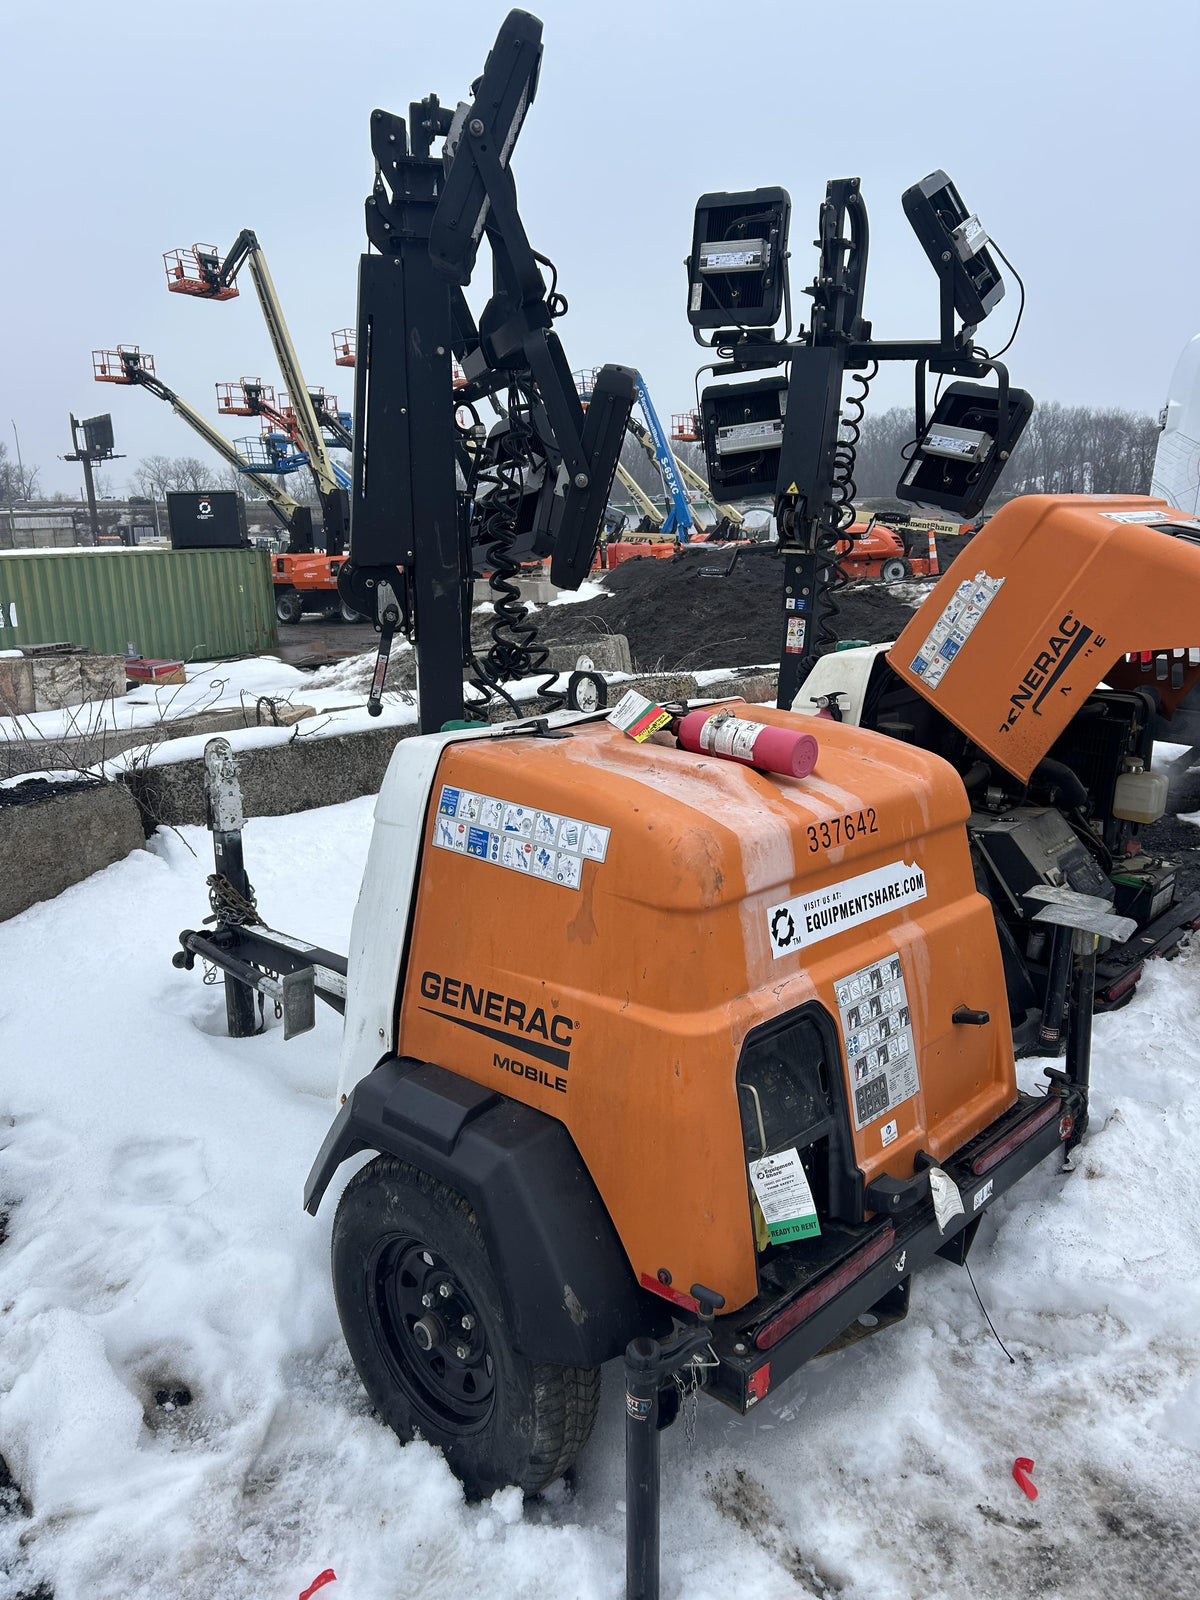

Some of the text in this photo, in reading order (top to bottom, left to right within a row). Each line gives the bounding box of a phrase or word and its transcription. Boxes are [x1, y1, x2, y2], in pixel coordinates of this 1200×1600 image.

[660, 457, 680, 495] S-65 XC
[806, 808, 879, 852] 337642
[803, 891, 842, 912] VISIT US AT:
[805, 874, 924, 933] EQUIPMENTSHARE.COM
[420, 971, 574, 1047] GENERAC
[492, 1053, 568, 1093] MOBILE
[764, 1161, 794, 1175] Equipment
[765, 1170, 782, 1179] Share
[770, 1227, 791, 1237] READY
[801, 1221, 817, 1231] RENT
